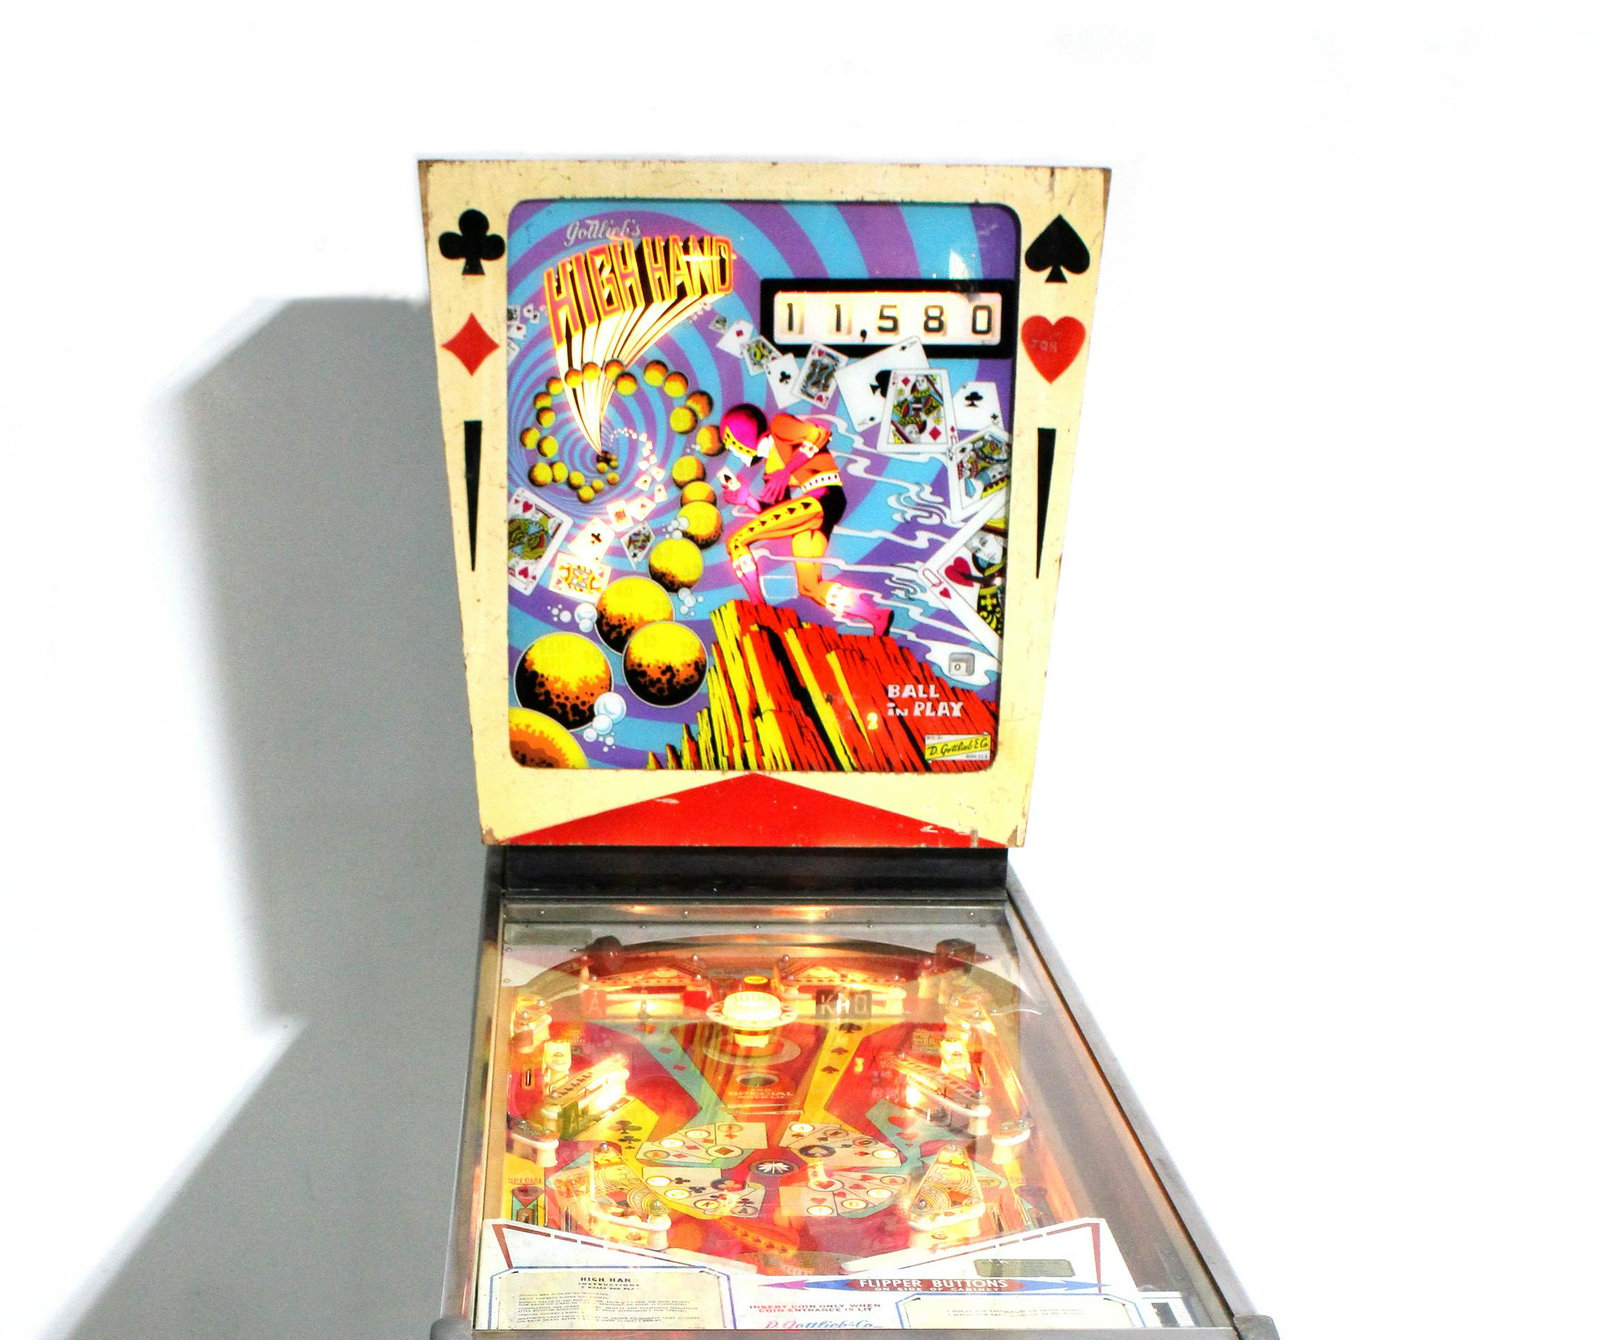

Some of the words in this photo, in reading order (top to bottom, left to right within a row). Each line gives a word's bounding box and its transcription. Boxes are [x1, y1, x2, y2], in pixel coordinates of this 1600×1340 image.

[544, 239, 645, 350] HIGH
[642, 235, 734, 303] HAND
[887, 684, 940, 699] BALL
[913, 701, 964, 717] PLAY
[859, 1279, 922, 1288] FLIPPER
[932, 1279, 1009, 1288] BUTTONS
